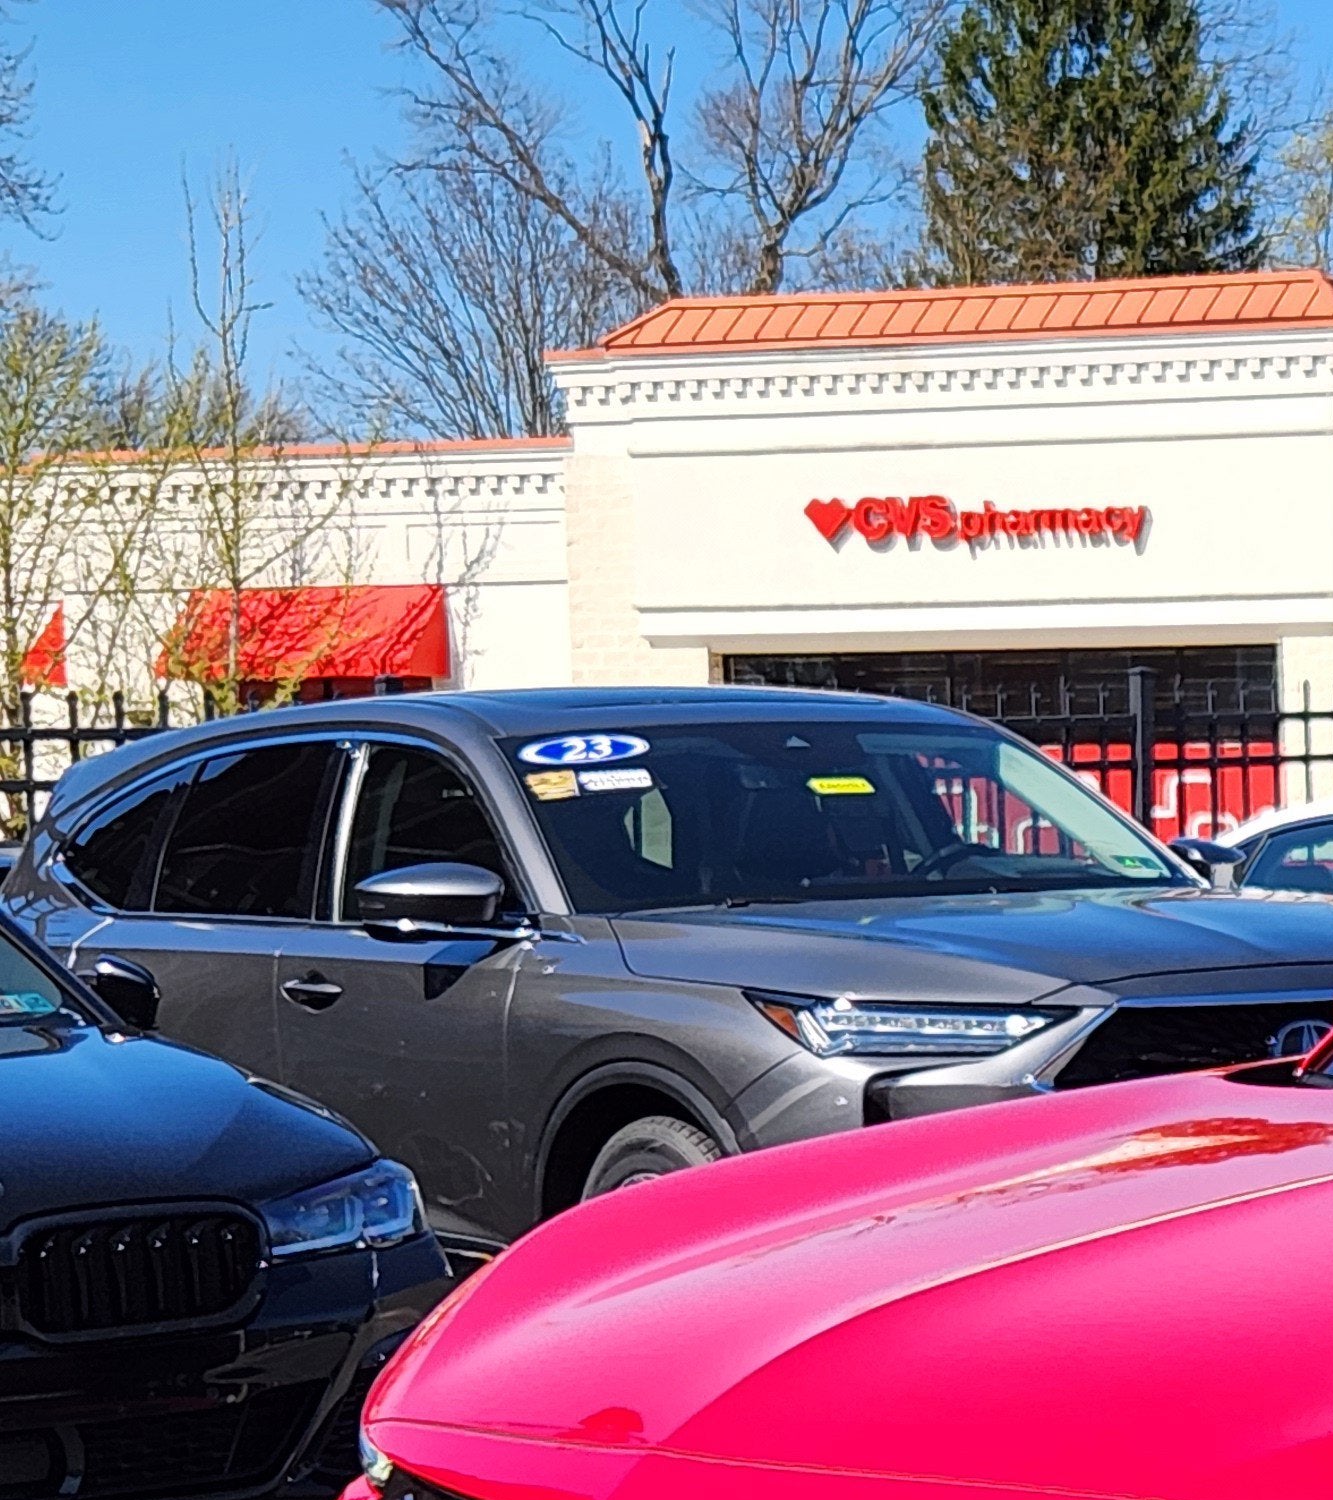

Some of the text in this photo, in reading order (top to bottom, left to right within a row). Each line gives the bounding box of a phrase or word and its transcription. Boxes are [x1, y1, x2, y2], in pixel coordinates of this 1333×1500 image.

[854, 495, 1147, 544] CVS pharmacy
[560, 735, 613, 761] 23
